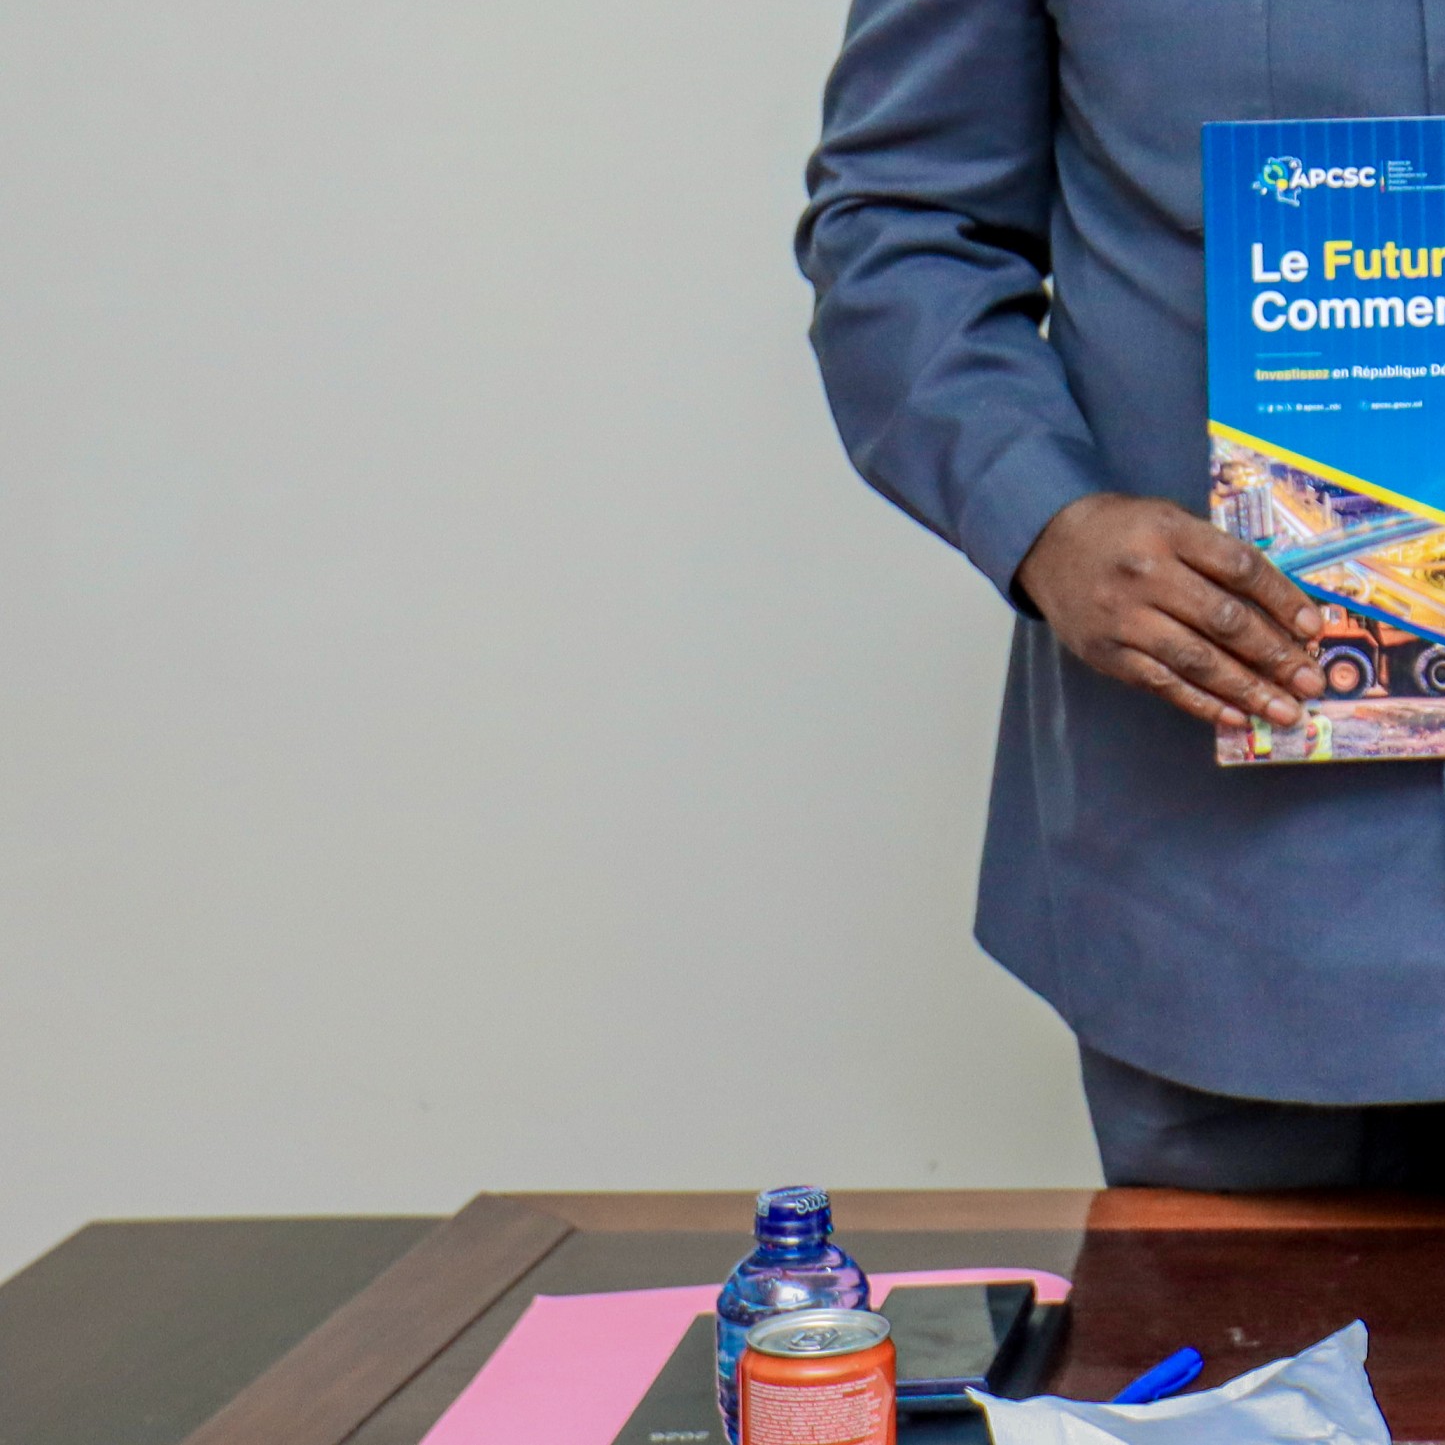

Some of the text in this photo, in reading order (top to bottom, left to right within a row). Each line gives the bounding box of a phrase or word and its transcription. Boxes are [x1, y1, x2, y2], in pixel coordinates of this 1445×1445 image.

[1289, 162, 1377, 190] APCSC
[1251, 242, 1309, 283] Le
[1255, 368, 1330, 381] Investissez
[1332, 369, 1349, 379] en
[1352, 365, 1428, 379] République
